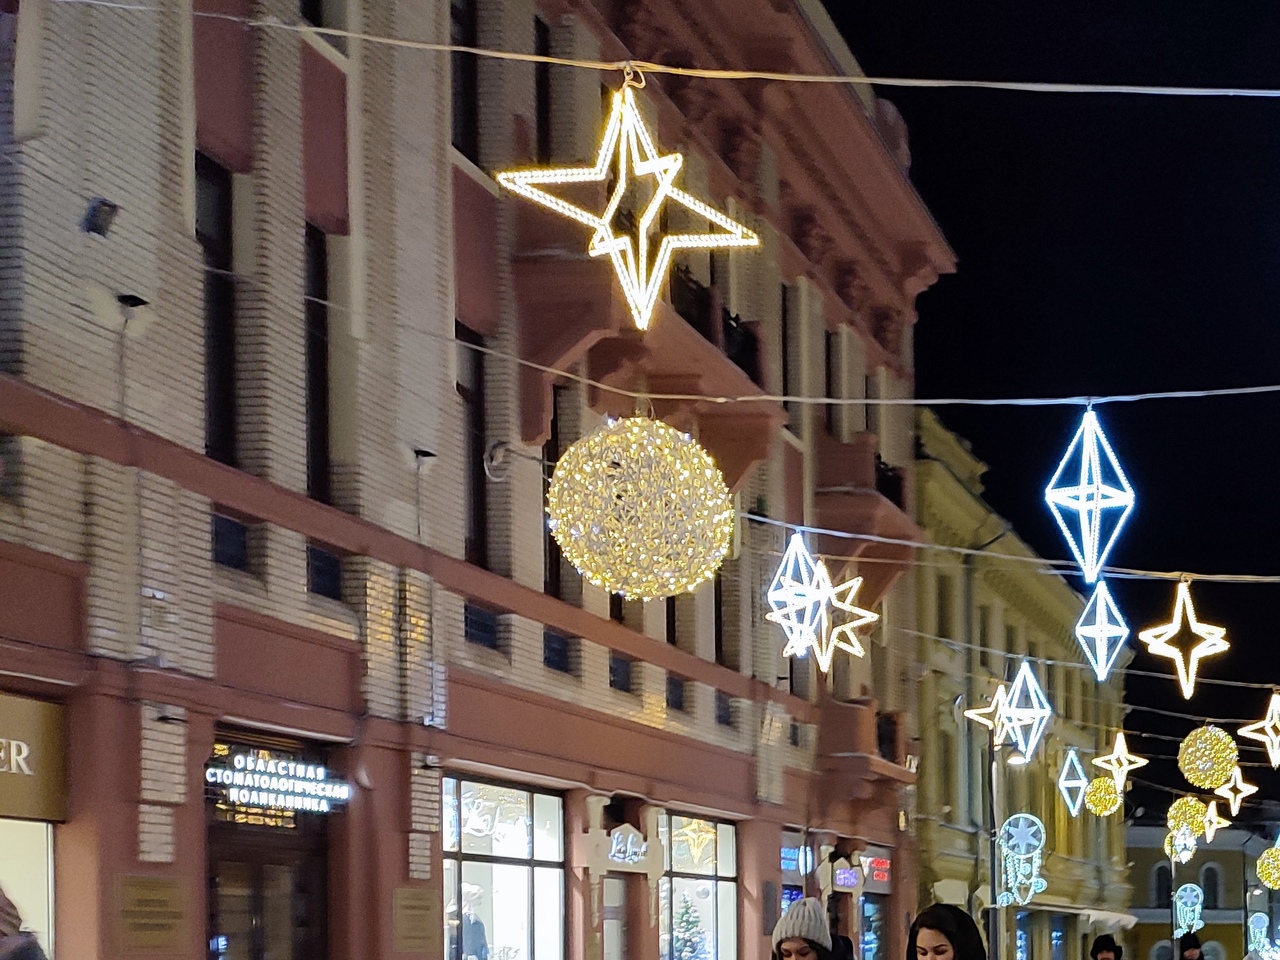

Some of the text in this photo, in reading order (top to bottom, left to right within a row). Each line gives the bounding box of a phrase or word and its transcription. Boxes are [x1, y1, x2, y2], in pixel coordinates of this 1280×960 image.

[233, 755, 325, 781] ОБЛАСТНАЯ
[205, 768, 350, 799] СТОМАТОЛОГИЧЕСКАЯ
[229, 787, 330, 813] ПОЛИКЛИНИКА
